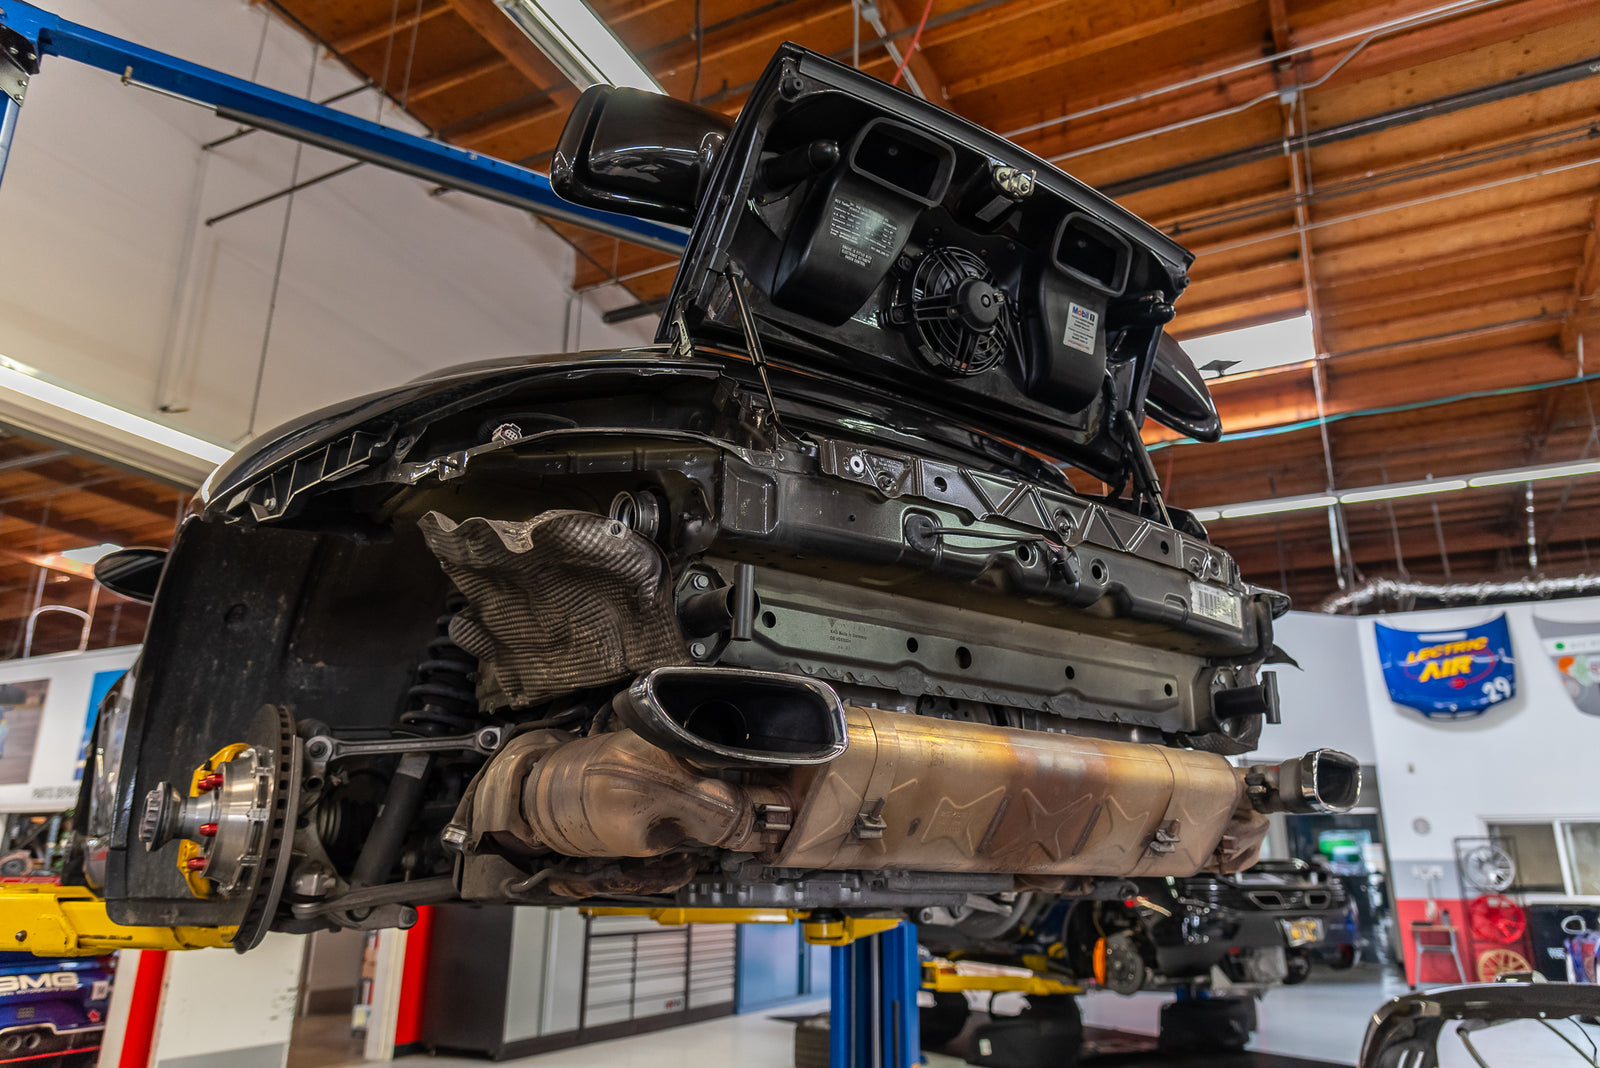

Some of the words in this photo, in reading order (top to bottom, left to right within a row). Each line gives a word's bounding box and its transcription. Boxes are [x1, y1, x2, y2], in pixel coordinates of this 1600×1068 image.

[1072, 306, 1089, 319] Mobil
[1418, 655, 1473, 683] AIR
[1481, 676, 1512, 703] 29
